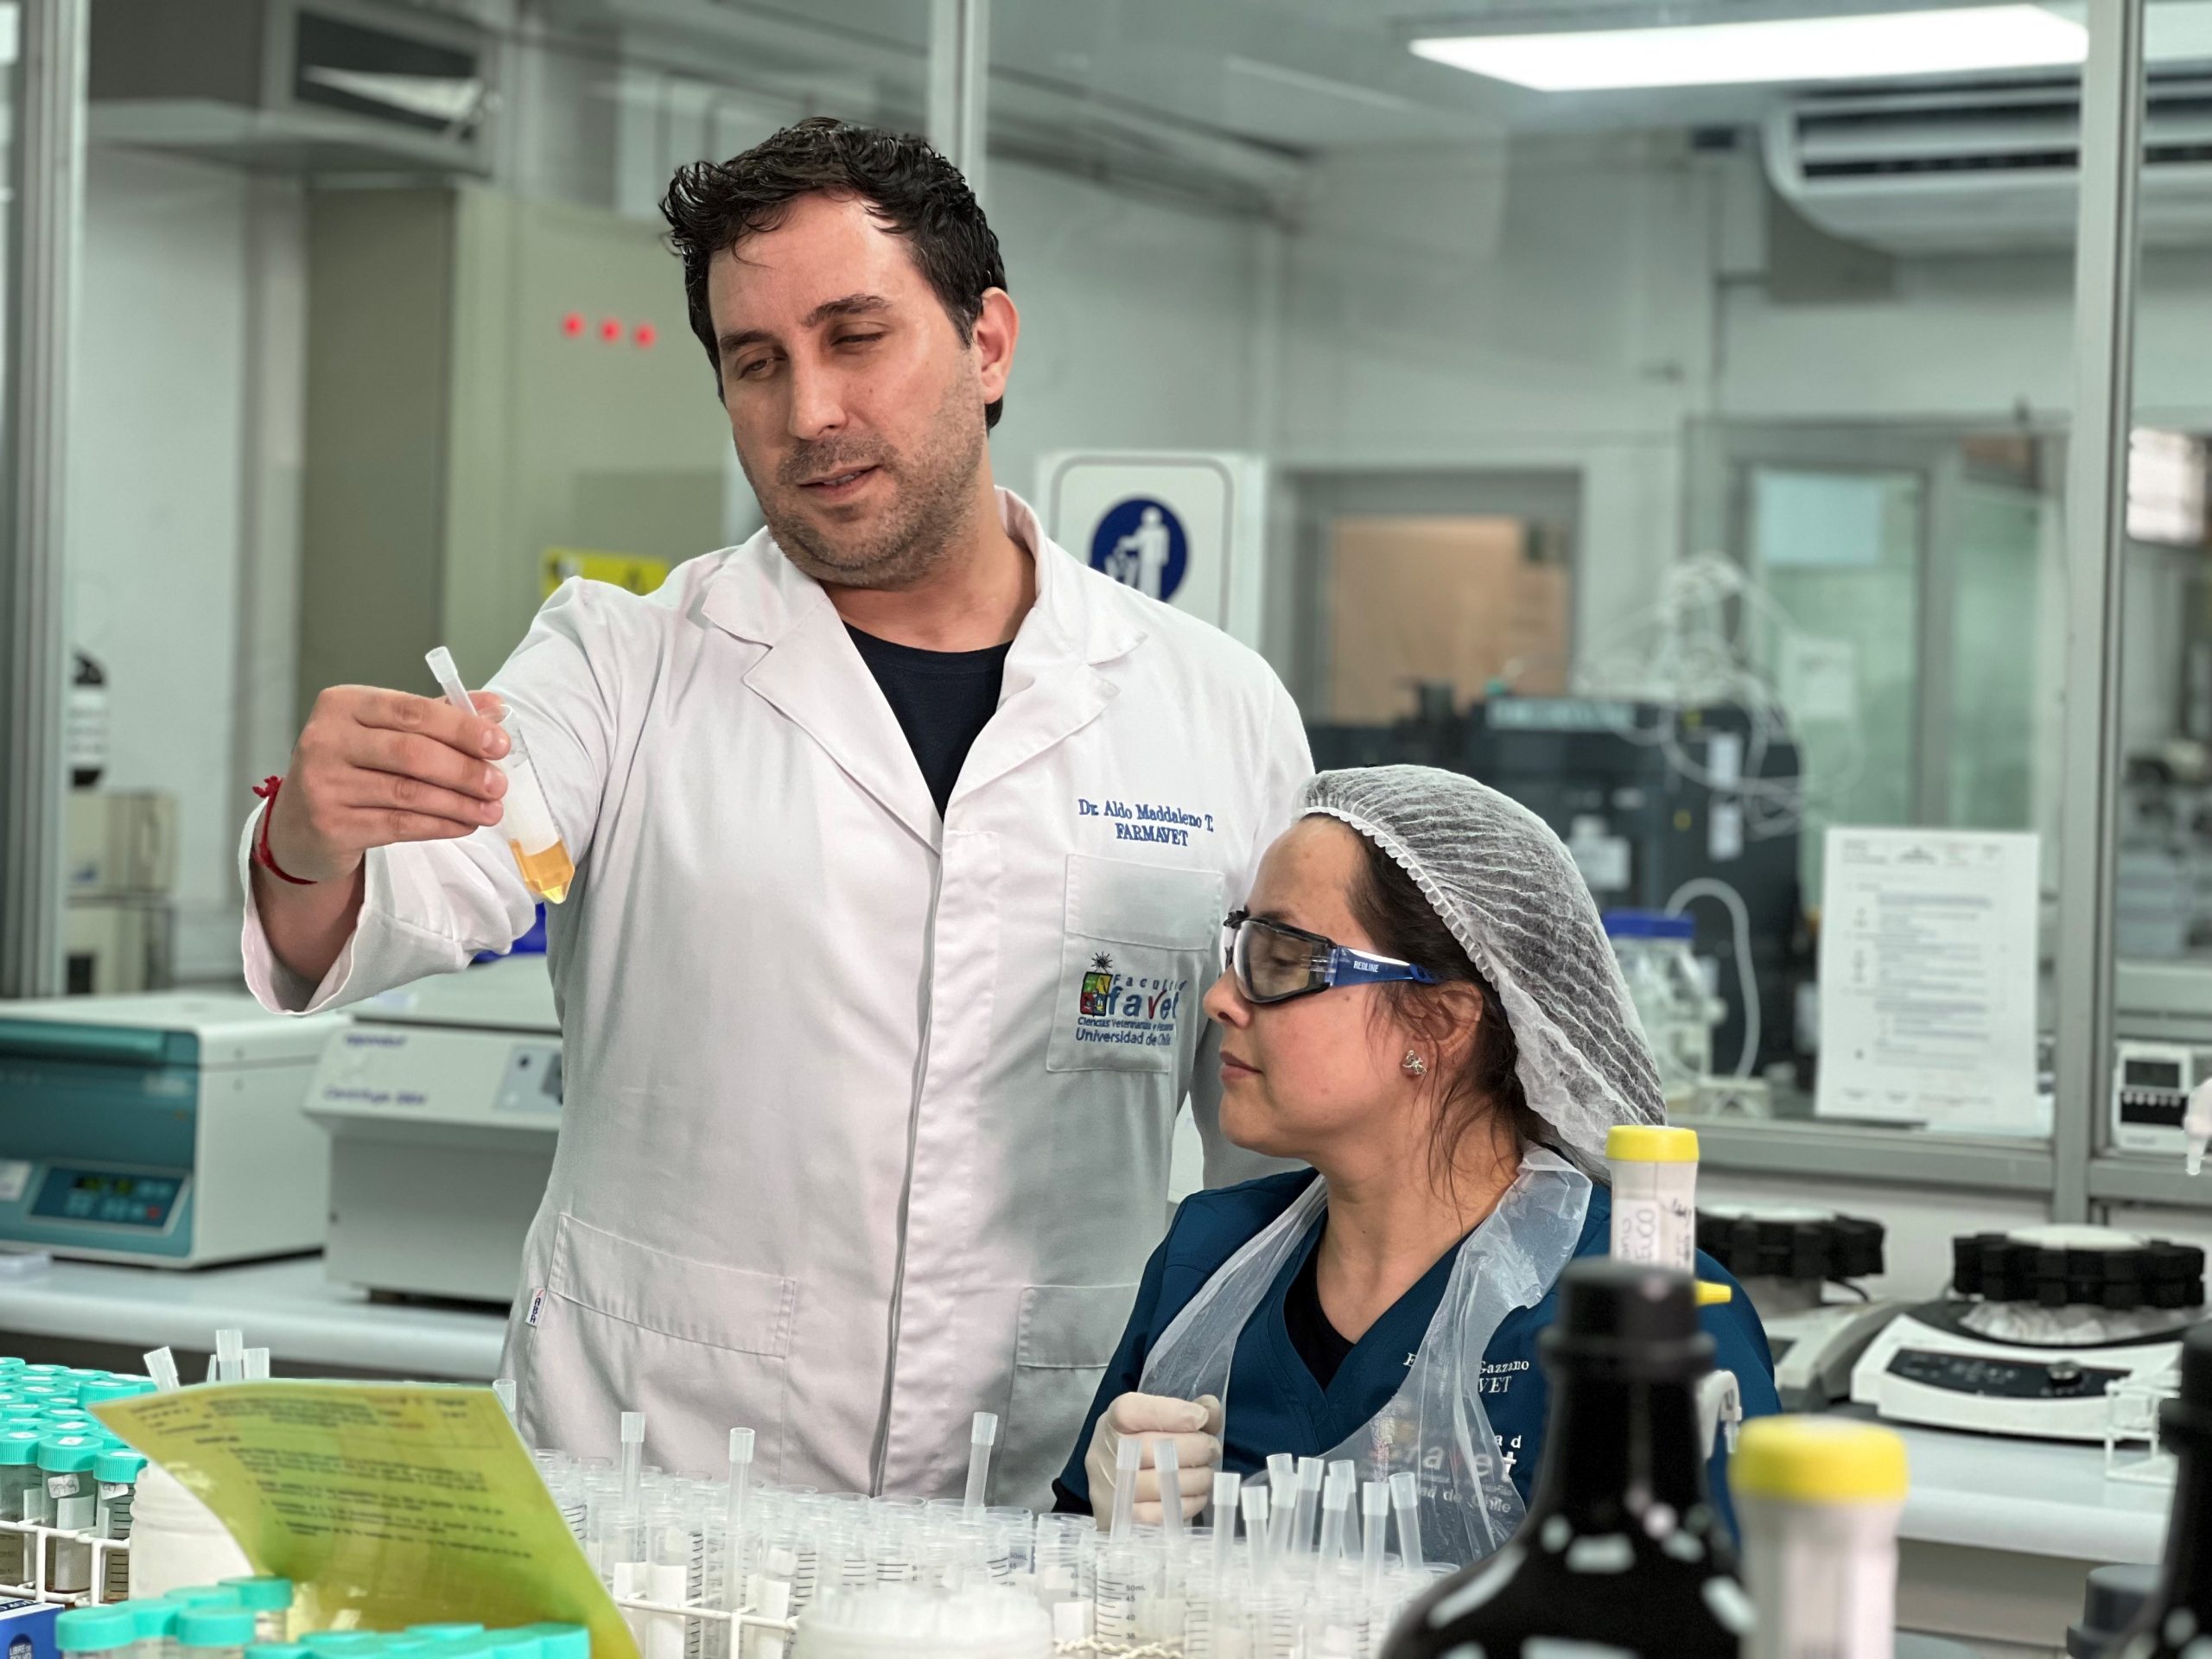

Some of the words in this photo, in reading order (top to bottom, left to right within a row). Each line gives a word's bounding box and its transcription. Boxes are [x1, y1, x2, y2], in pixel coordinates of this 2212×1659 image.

[1078, 798, 1099, 817] Dr.
[1104, 800, 1133, 820] Aldo
[1135, 804, 1203, 829] Maddaleno
[1205, 814, 1214, 832] T.
[1115, 823, 1189, 847] FARMAVET
[1076, 1027, 1144, 1045] Universidad
[1146, 1033, 1157, 1046] de
[1480, 1360, 1529, 1374] Gazzano
[10, 1643, 26, 1656] LIBRE
